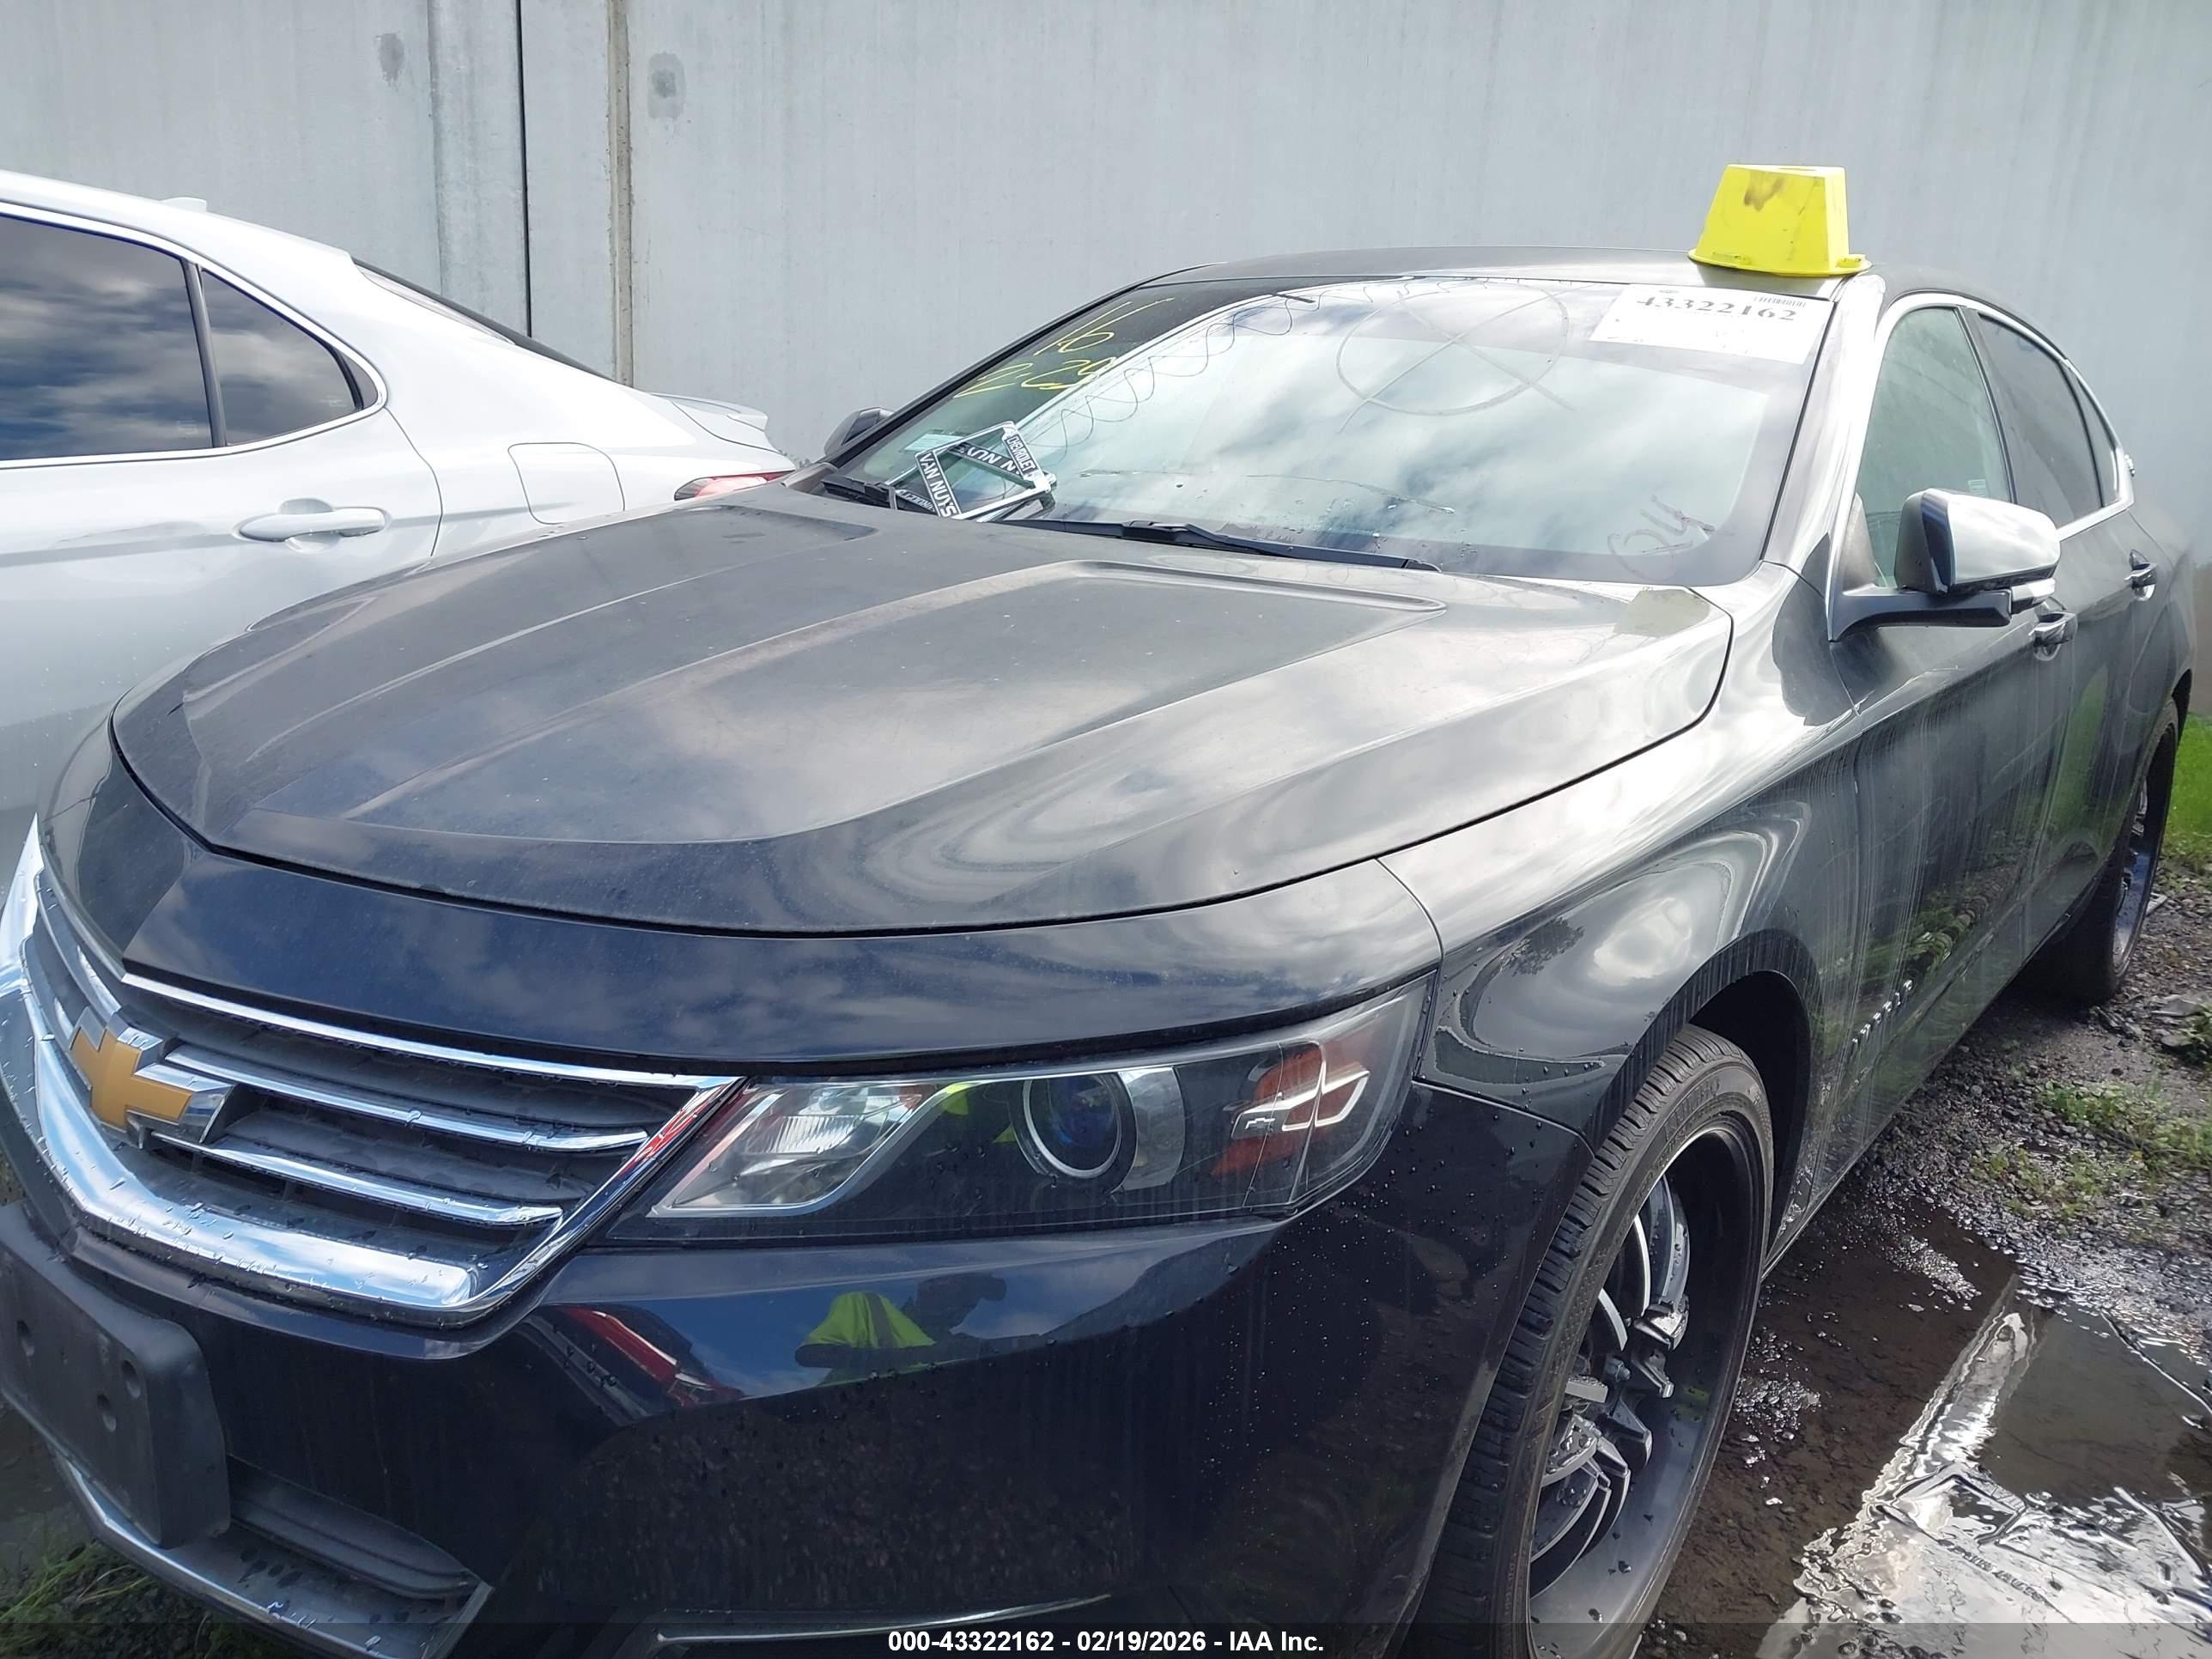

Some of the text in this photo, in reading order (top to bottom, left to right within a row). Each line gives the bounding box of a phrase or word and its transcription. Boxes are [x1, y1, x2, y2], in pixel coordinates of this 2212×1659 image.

[1636, 295, 1796, 321] 43322162
[1007, 436, 1036, 473] CHEVROLET
[919, 453, 957, 518] VAN NUYS
